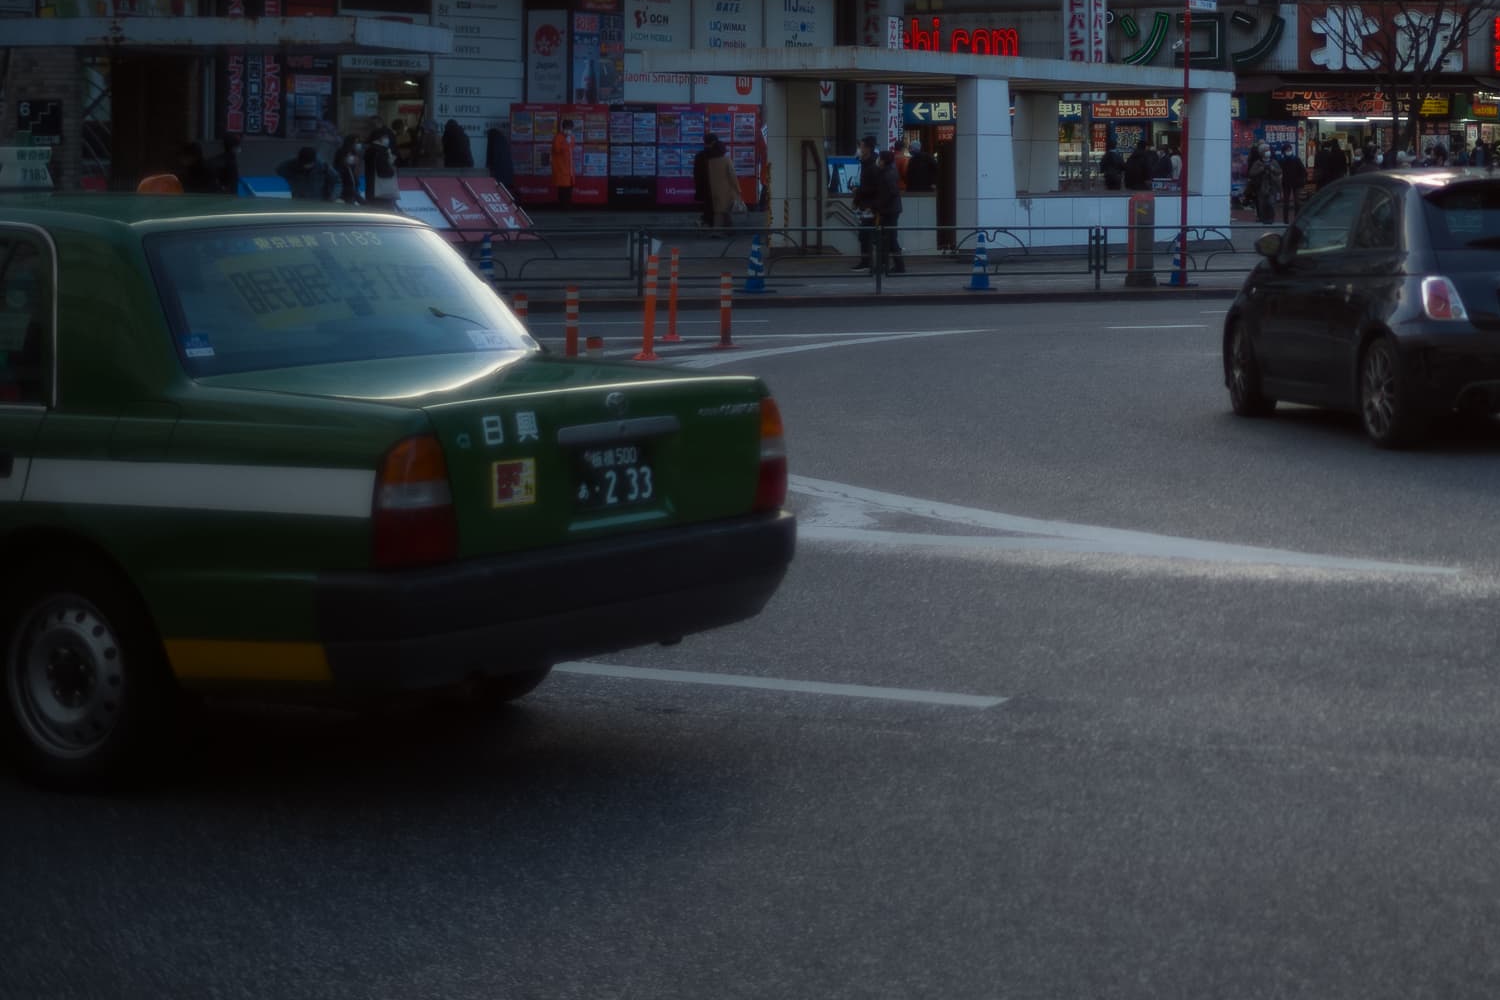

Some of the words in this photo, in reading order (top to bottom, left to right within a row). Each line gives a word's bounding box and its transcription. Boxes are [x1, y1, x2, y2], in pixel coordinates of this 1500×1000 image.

[650, 14, 680, 25] OCN
[1311, 4, 1464, 72] 北館
[1145, 107, 1167, 116] 10:30
[321, 231, 383, 248] 7183
[482, 410, 540, 446] 日興
[615, 447, 638, 465] 500
